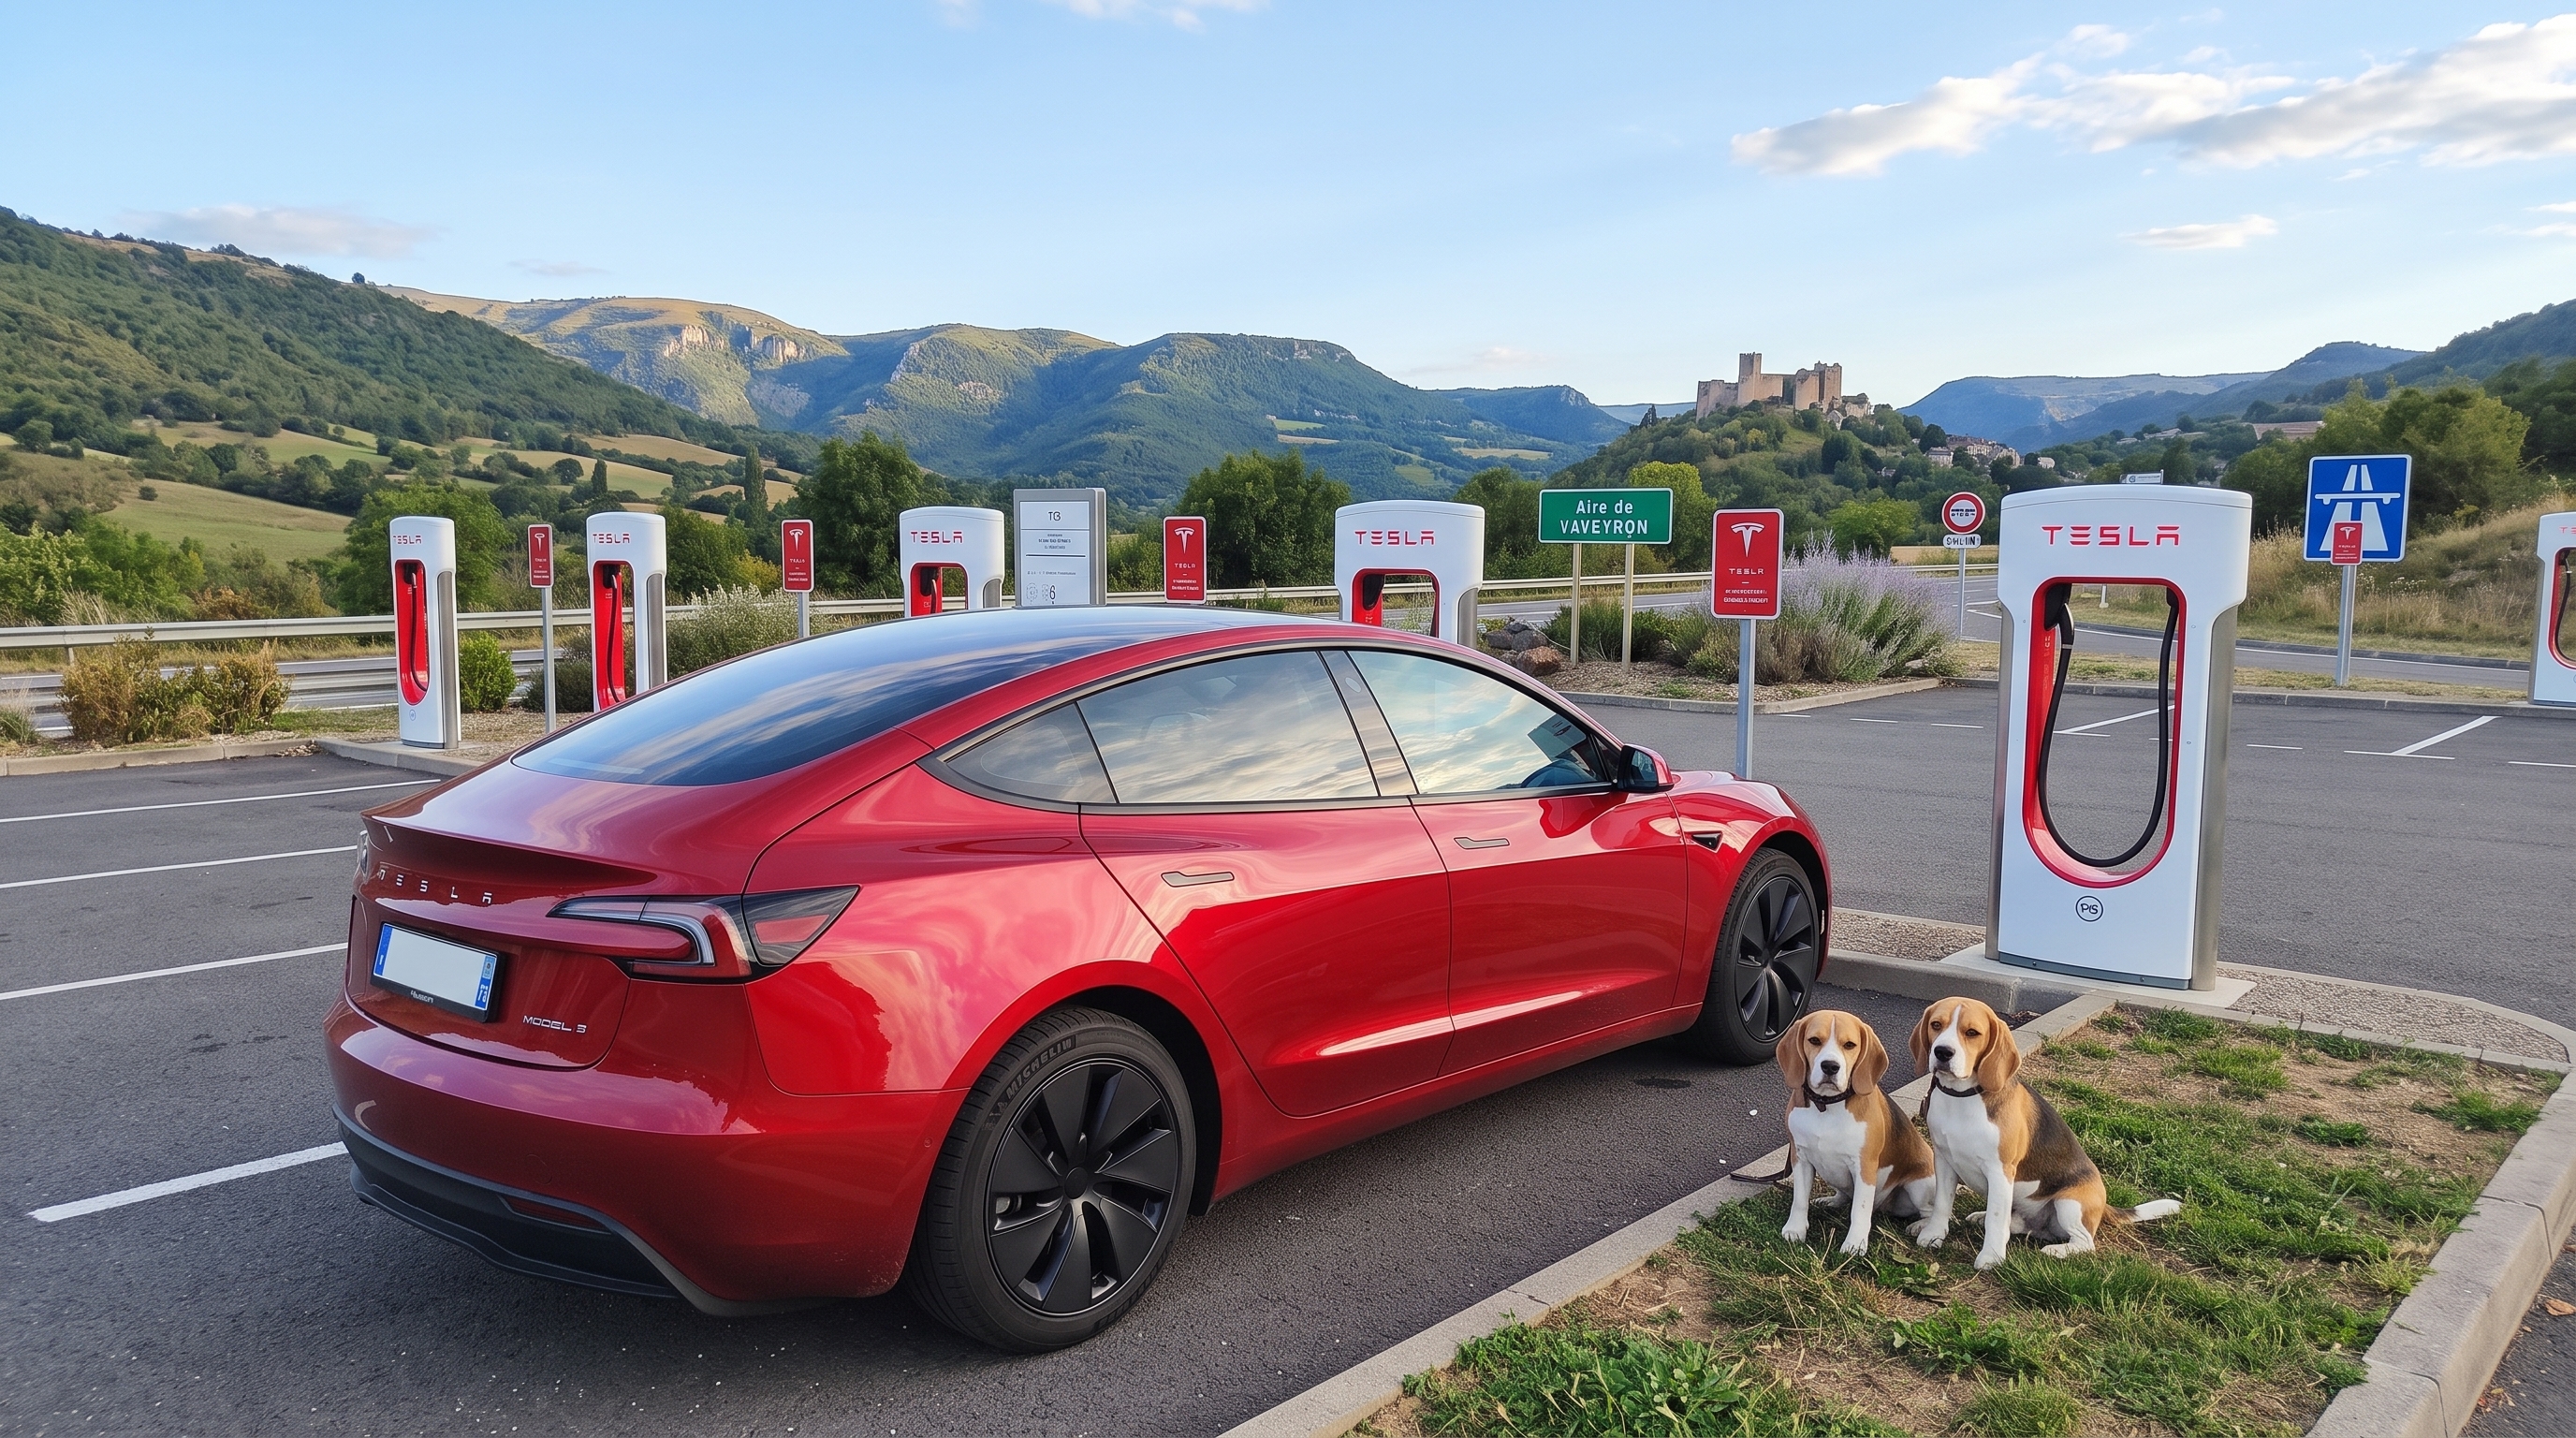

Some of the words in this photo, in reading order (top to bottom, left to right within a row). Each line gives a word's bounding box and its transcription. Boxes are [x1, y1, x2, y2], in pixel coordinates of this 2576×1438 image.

[1575, 499, 1607, 514] Aire
[1614, 499, 1633, 514] de
[1560, 519, 1647, 535] VAVEYRON
[592, 533, 631, 544] TESLA
[910, 530, 964, 544] TESLA
[1354, 530, 1435, 546] TESLA
[2040, 525, 2181, 547] TESLA
